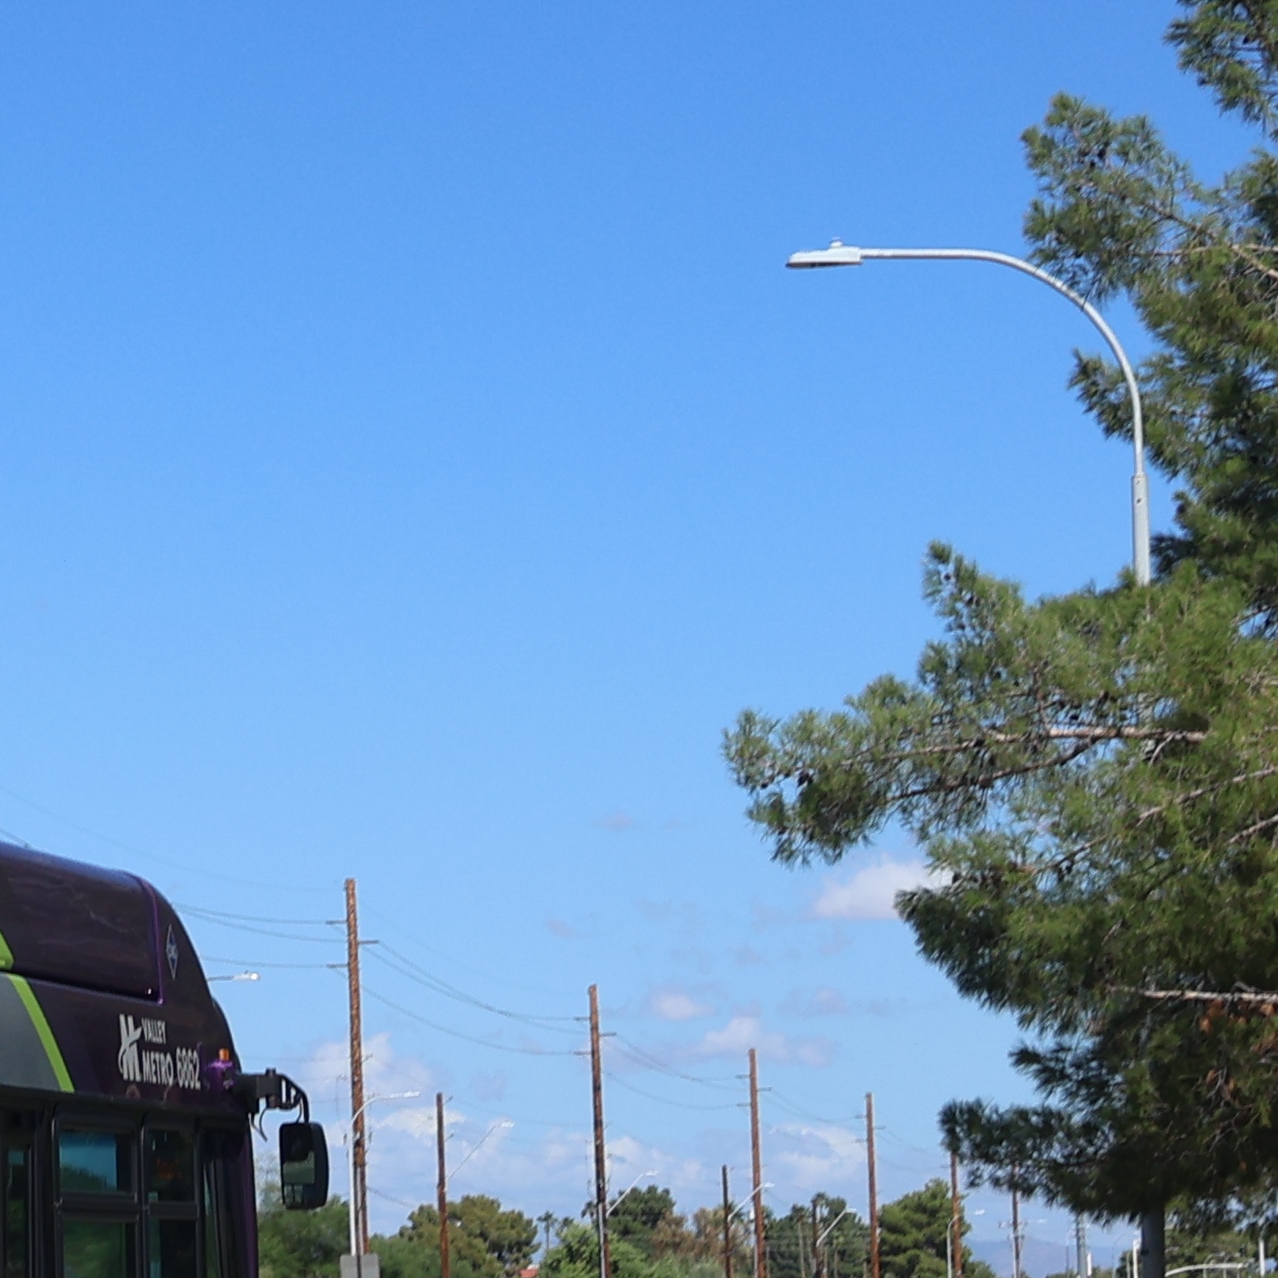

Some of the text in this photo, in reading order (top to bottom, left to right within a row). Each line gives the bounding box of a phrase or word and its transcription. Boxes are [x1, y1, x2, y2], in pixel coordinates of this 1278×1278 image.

[141, 1017, 166, 1044] VALLEY
[142, 1046, 201, 1090] METRO 6862
